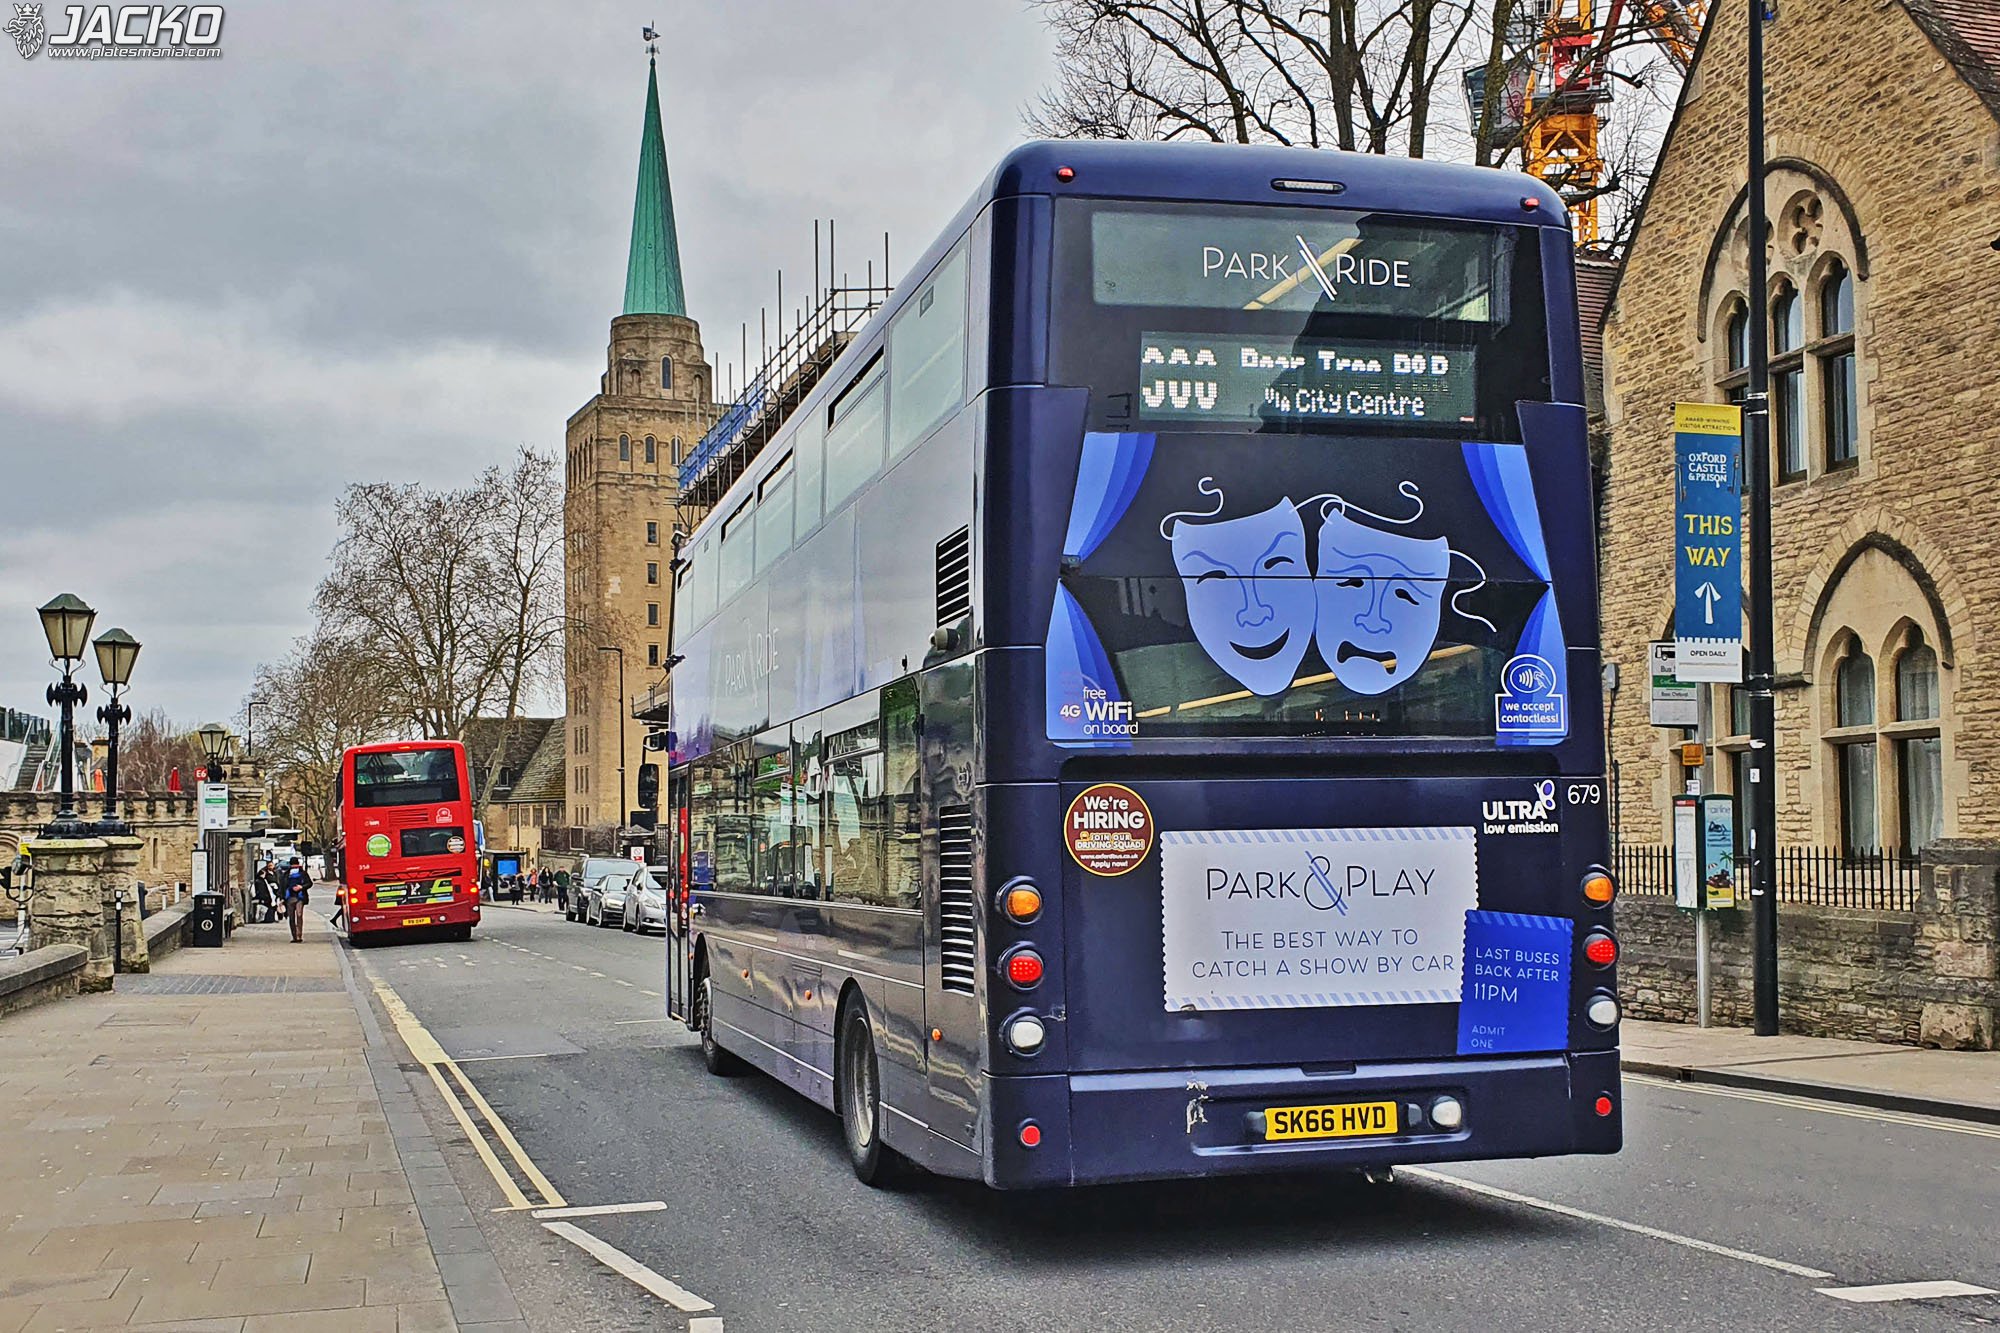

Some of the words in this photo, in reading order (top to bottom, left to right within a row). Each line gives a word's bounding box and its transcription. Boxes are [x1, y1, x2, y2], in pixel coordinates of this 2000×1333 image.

[1202, 246, 1292, 280] PARK
[1335, 253, 1411, 288] RIDE
[1296, 387, 1342, 414] City
[1347, 390, 1425, 416] Centre
[1688, 452, 1727, 463] OXFORD
[1688, 463, 1727, 474] CASTLE
[1696, 473, 1727, 485] PRISON
[1683, 514, 1733, 536] THIS
[1684, 546, 1731, 567] WAY
[1083, 686, 1106, 700] free
[1060, 705, 1081, 717] 4G
[1084, 701, 1133, 721] WiFi
[1505, 702, 1520, 711] we
[1522, 701, 1554, 712] accept
[1083, 725, 1100, 734] on
[1102, 722, 1139, 735] board
[196, 770, 207, 778] E6
[1083, 795, 1129, 810] We're
[1567, 784, 1600, 805] 679
[1073, 811, 1145, 829] HIRING
[1482, 801, 1548, 821] ULTRA
[1091, 833, 1111, 841] JOIN
[1112, 833, 1131, 841] OUR
[1483, 823, 1505, 835] low
[1508, 821, 1559, 834] emission
[1076, 840, 1112, 850] DRIVING
[1090, 861, 1111, 869] Apply
[1207, 868, 1300, 899] PARK
[1347, 865, 1435, 897] PLAY
[1221, 931, 1264, 950] THE
[1273, 931, 1326, 949] BEST
[1334, 930, 1383, 947] WAY
[1391, 929, 1418, 945] TO
[1475, 947, 1510, 960] LAST
[1515, 950, 1560, 965] BUSES
[1192, 960, 1267, 978] CATCH
[1276, 959, 1291, 976] A
[1300, 957, 1369, 975] SHOW
[1377, 956, 1403, 973] BY
[1412, 954, 1455, 972] CAR
[1475, 964, 1512, 978] BACK
[1516, 968, 1559, 982] AFTER
[1474, 982, 1518, 1003] 11PM
[1471, 1025, 1506, 1036] ADMIT
[1471, 1038, 1494, 1048] ONE
[1274, 1108, 1335, 1134] SK66
[1342, 1106, 1386, 1131] HVD
